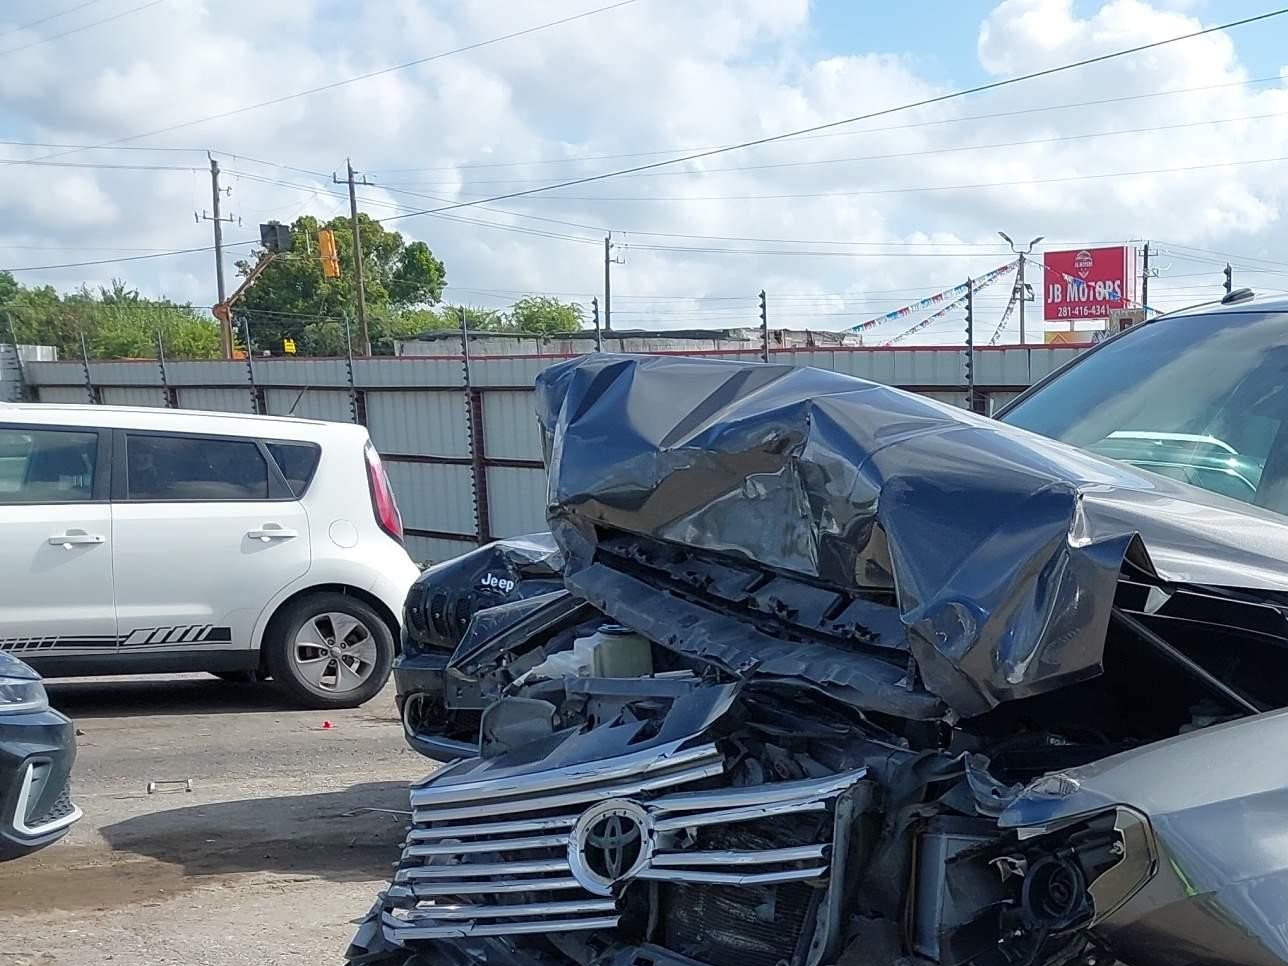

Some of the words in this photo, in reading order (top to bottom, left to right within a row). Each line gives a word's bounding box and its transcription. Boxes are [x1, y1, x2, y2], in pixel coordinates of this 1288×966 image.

[1047, 283, 1062, 303] JB
[1067, 280, 1121, 302] MOTORS
[1057, 304, 1110, 317] 281-416-4341
[481, 572, 514, 593] Jeep
